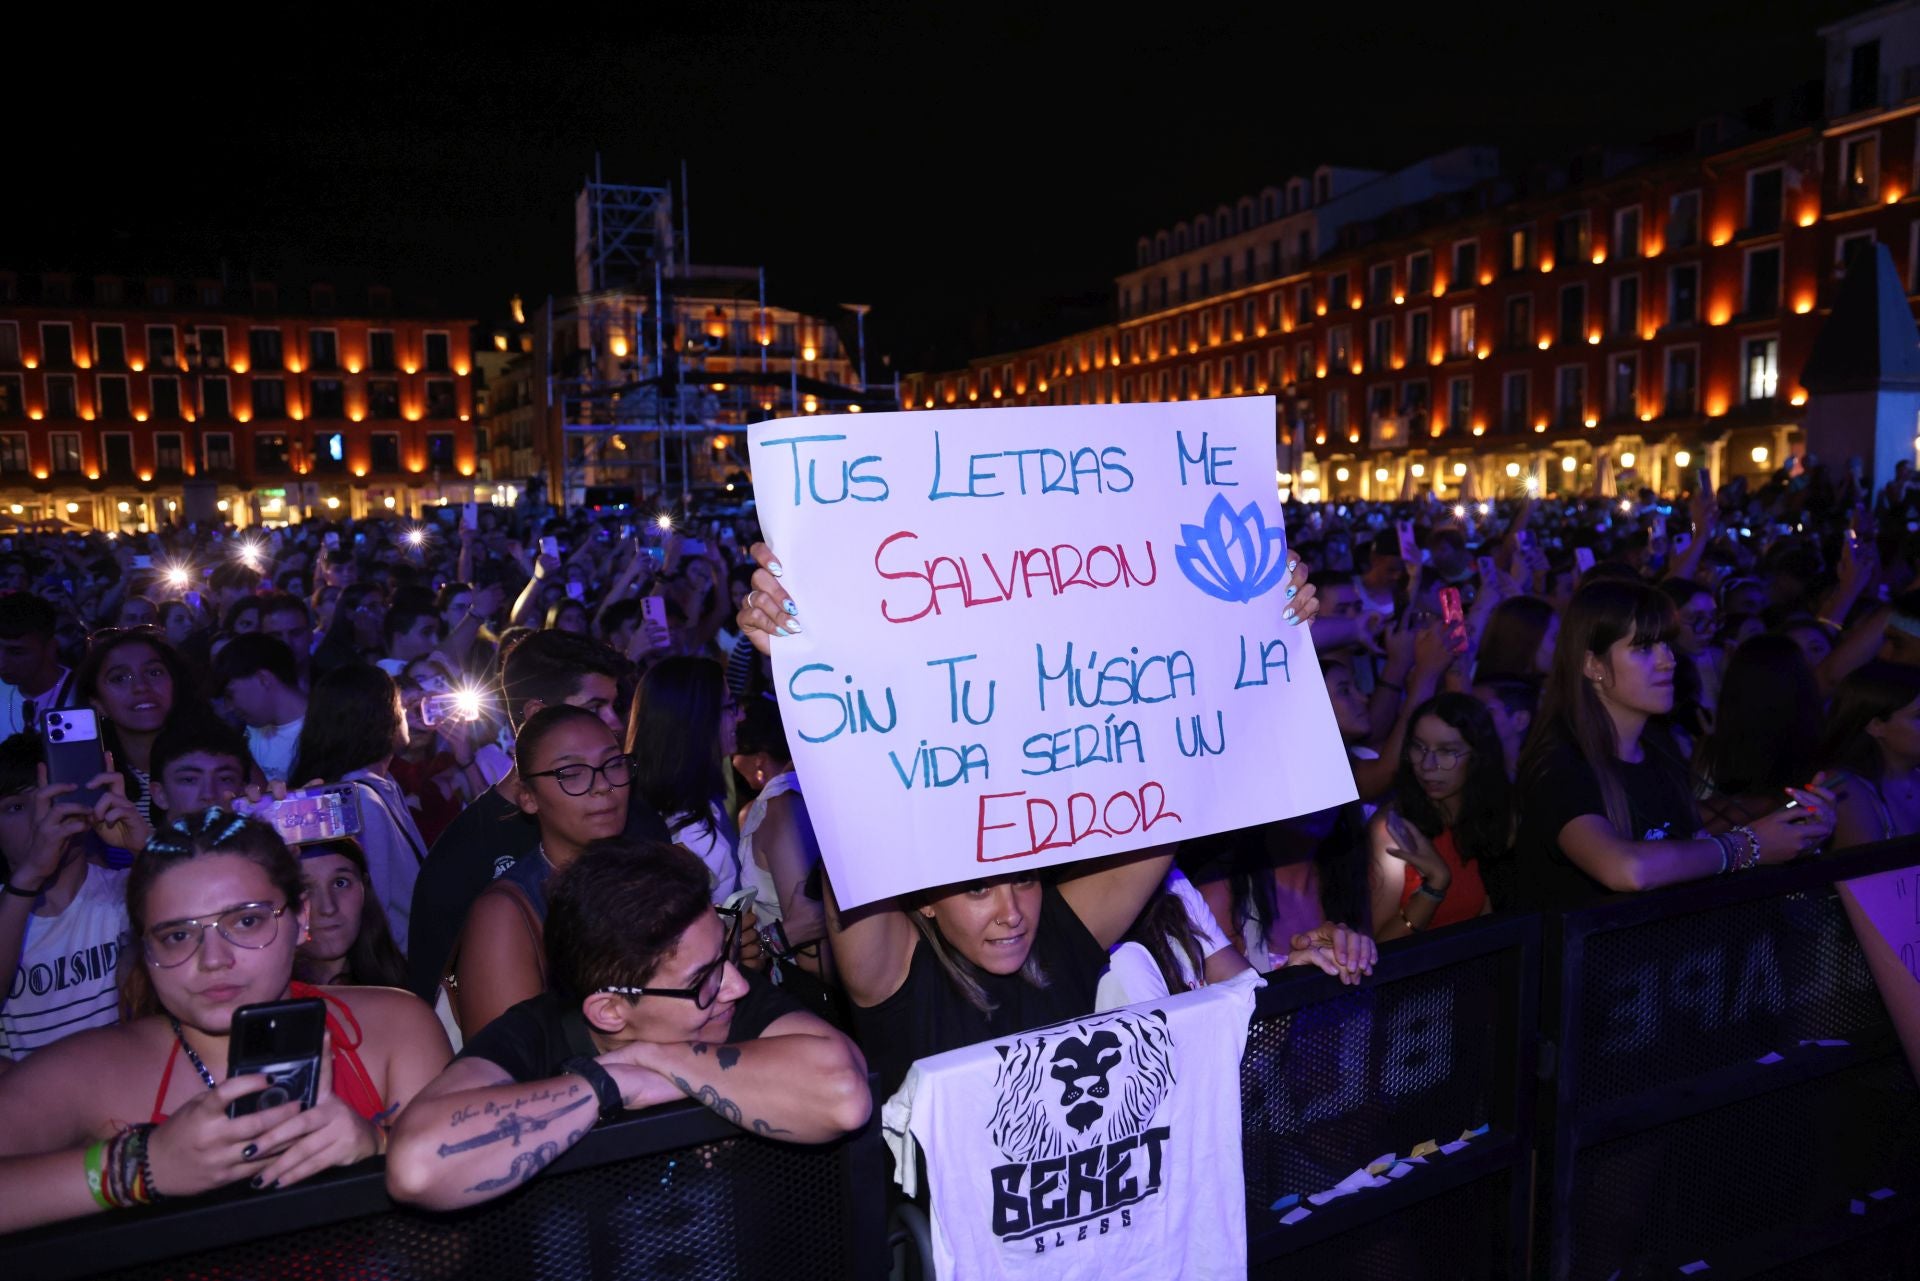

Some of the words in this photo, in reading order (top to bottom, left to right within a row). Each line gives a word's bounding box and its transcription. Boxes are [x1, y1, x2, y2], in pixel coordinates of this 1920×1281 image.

[760, 434, 889, 506] TUS
[928, 431, 1134, 501] LETRAS
[1177, 431, 1238, 486] ME
[875, 531, 1157, 623] SALVARON
[927, 654, 995, 725] TU
[1234, 635, 1290, 690] LA
[1176, 710, 1225, 757] UN
[977, 781, 1181, 862] ERROR
[991, 1126, 1170, 1237] BERET
